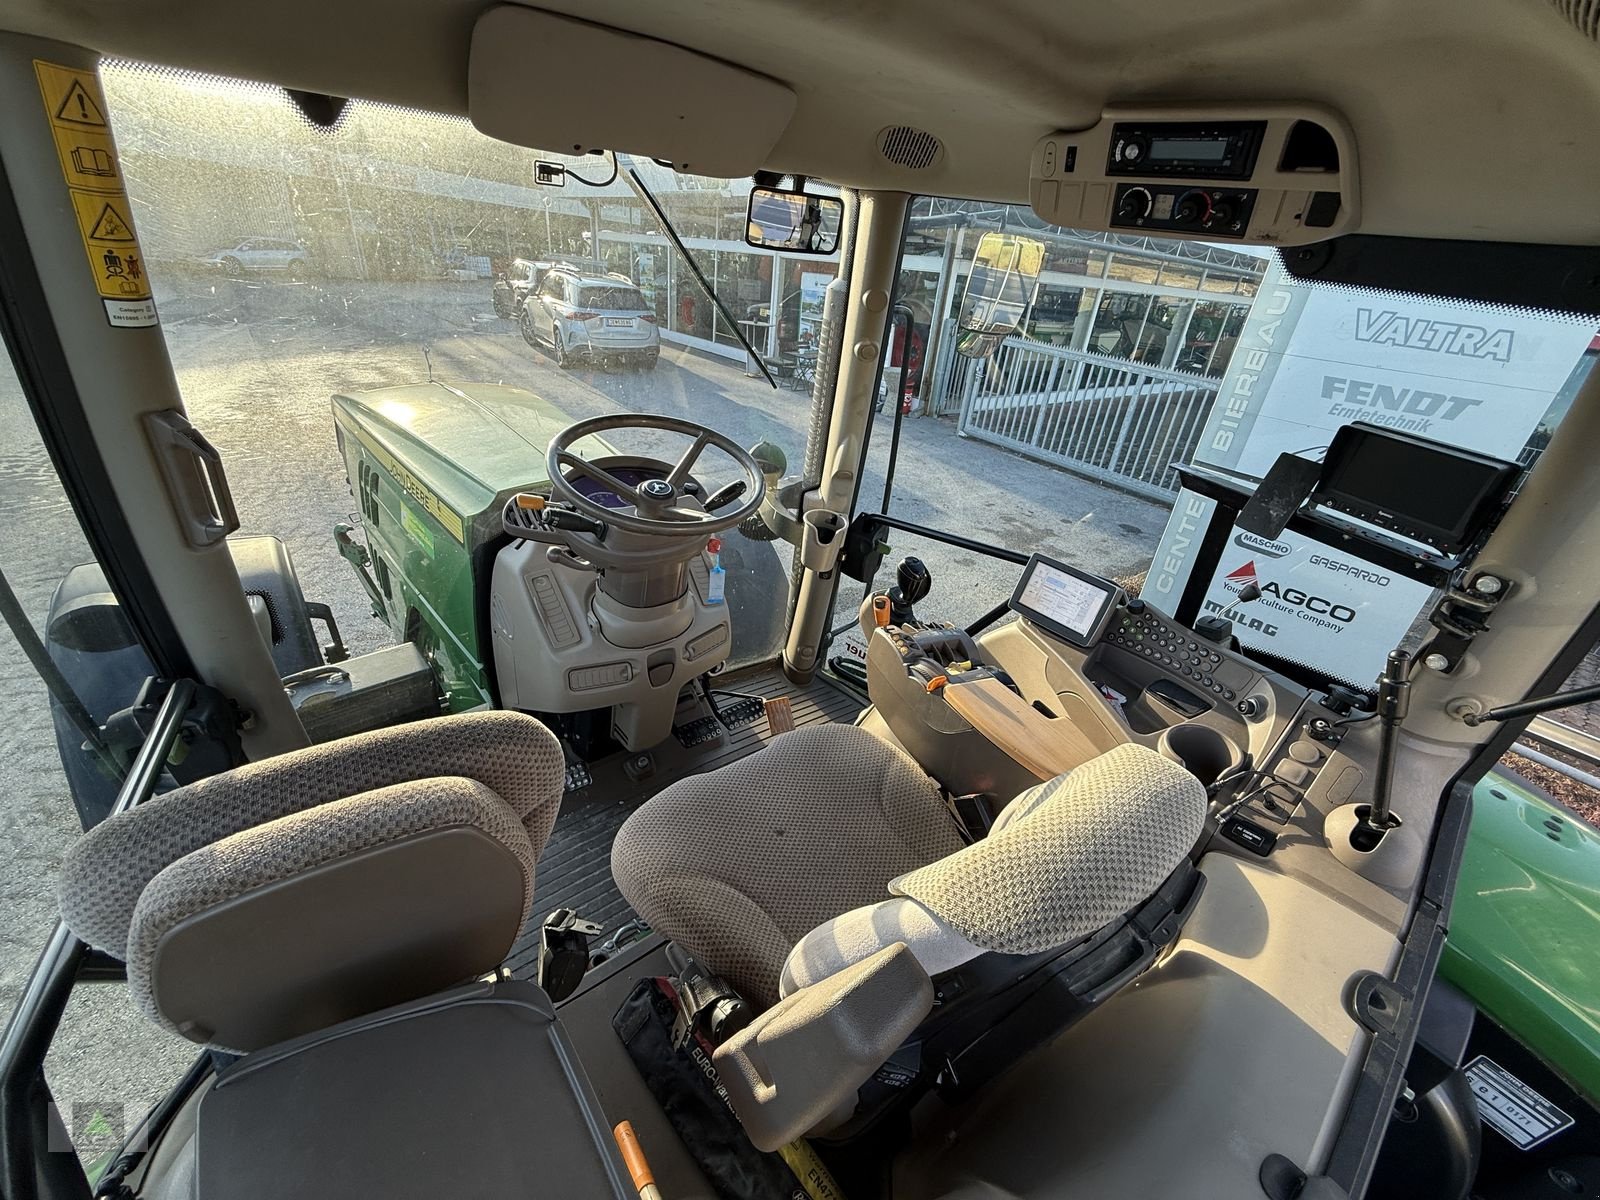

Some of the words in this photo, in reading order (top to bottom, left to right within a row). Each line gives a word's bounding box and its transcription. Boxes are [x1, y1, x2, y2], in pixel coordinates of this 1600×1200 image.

[1355, 308, 1515, 362] VALTRA
[1321, 375, 1484, 421] FENDT
[1328, 403, 1434, 434] Erntetechnik
[1156, 497, 1207, 594] CENTE
[1243, 533, 1289, 554] MASCHIO
[1309, 554, 1391, 587] GASPARDO
[1254, 594, 1294, 615] iculture
[1296, 610, 1344, 634] Company
[1261, 581, 1357, 623] AGCO
[1506, 1105, 1532, 1125] 0171
